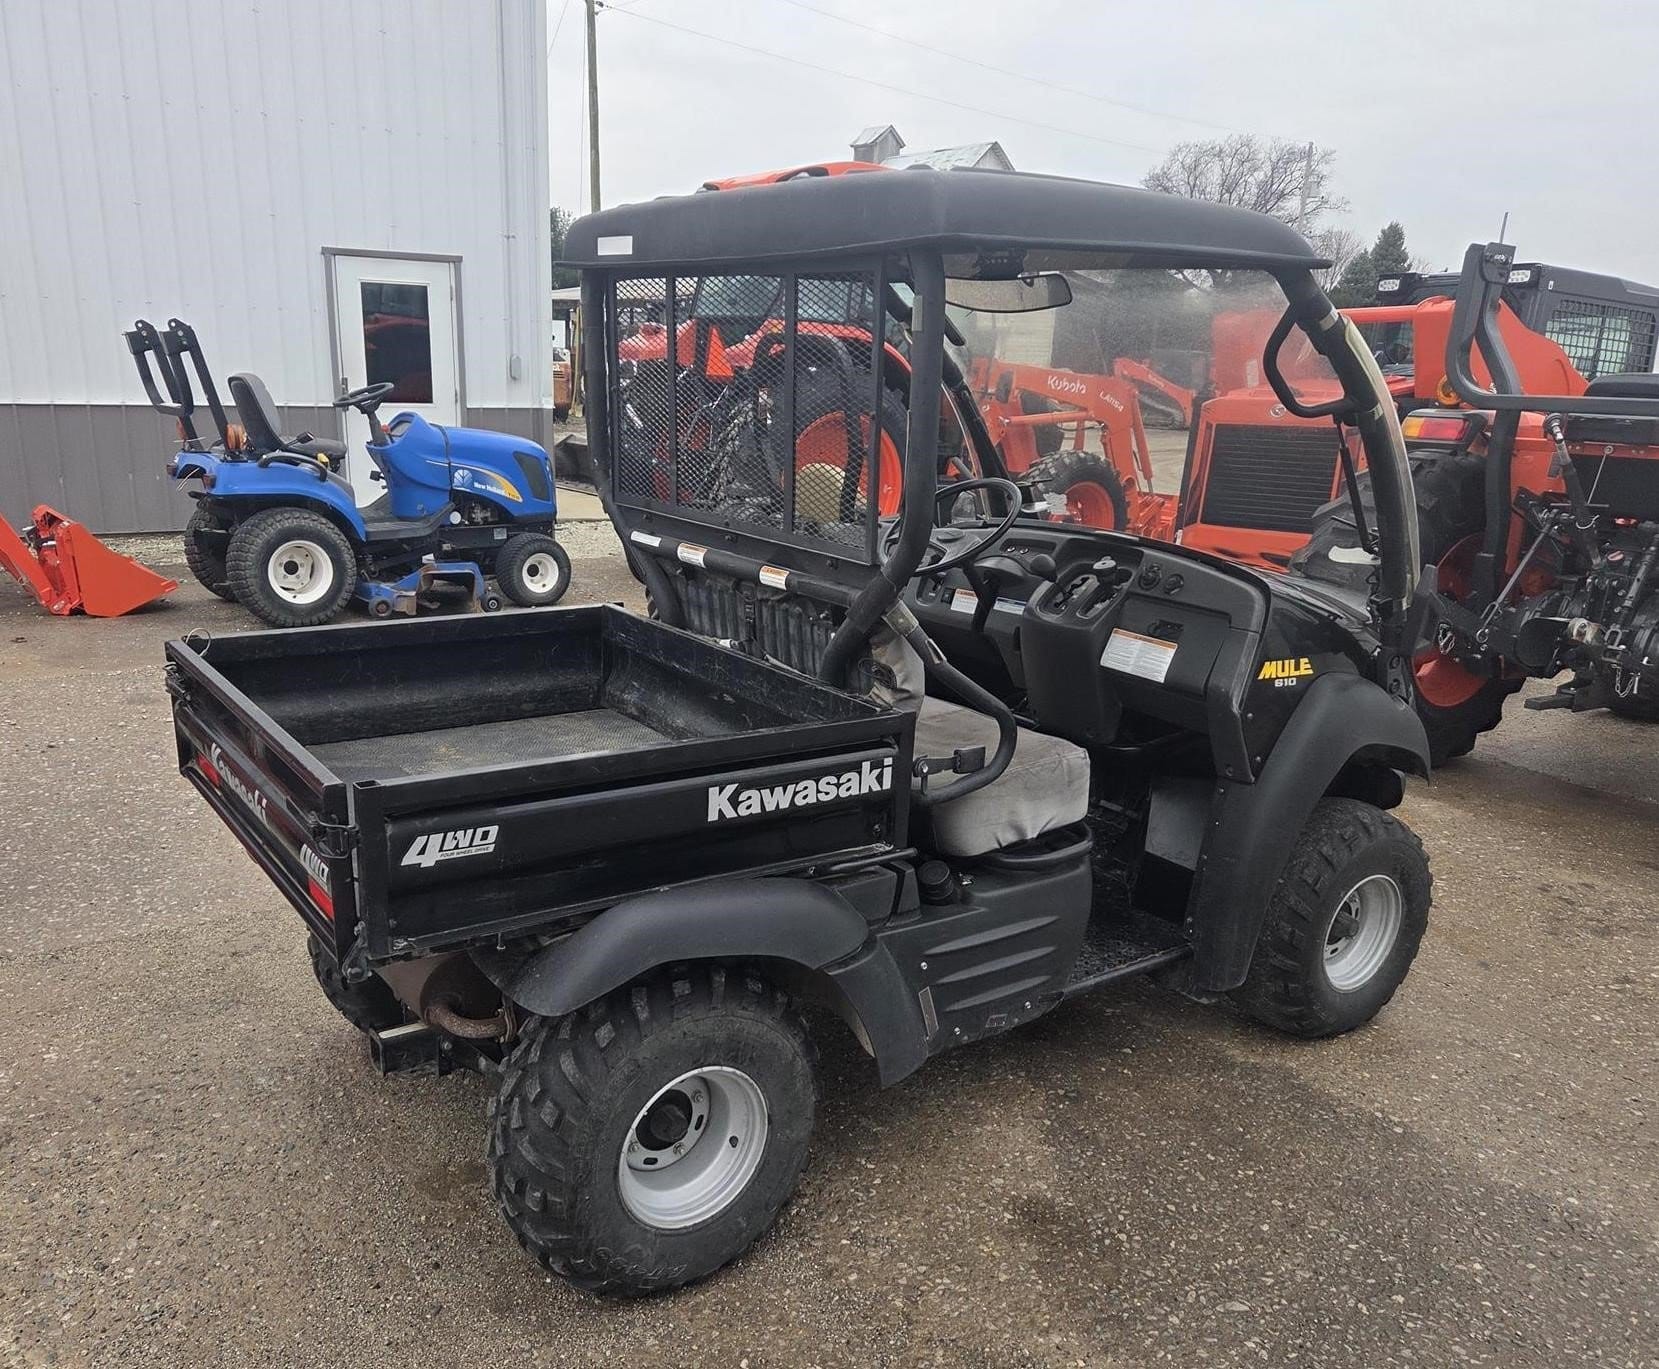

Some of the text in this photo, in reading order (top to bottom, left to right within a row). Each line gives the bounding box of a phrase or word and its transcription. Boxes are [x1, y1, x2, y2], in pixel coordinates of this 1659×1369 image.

[1047, 375, 1087, 394] Kubota
[473, 481, 486, 490] New
[1257, 657, 1314, 680] MULE
[1274, 677, 1297, 688] 610
[210, 742, 270, 830] Kawasaki
[708, 757, 893, 822] Kawasaki
[400, 825, 499, 868] 4WD
